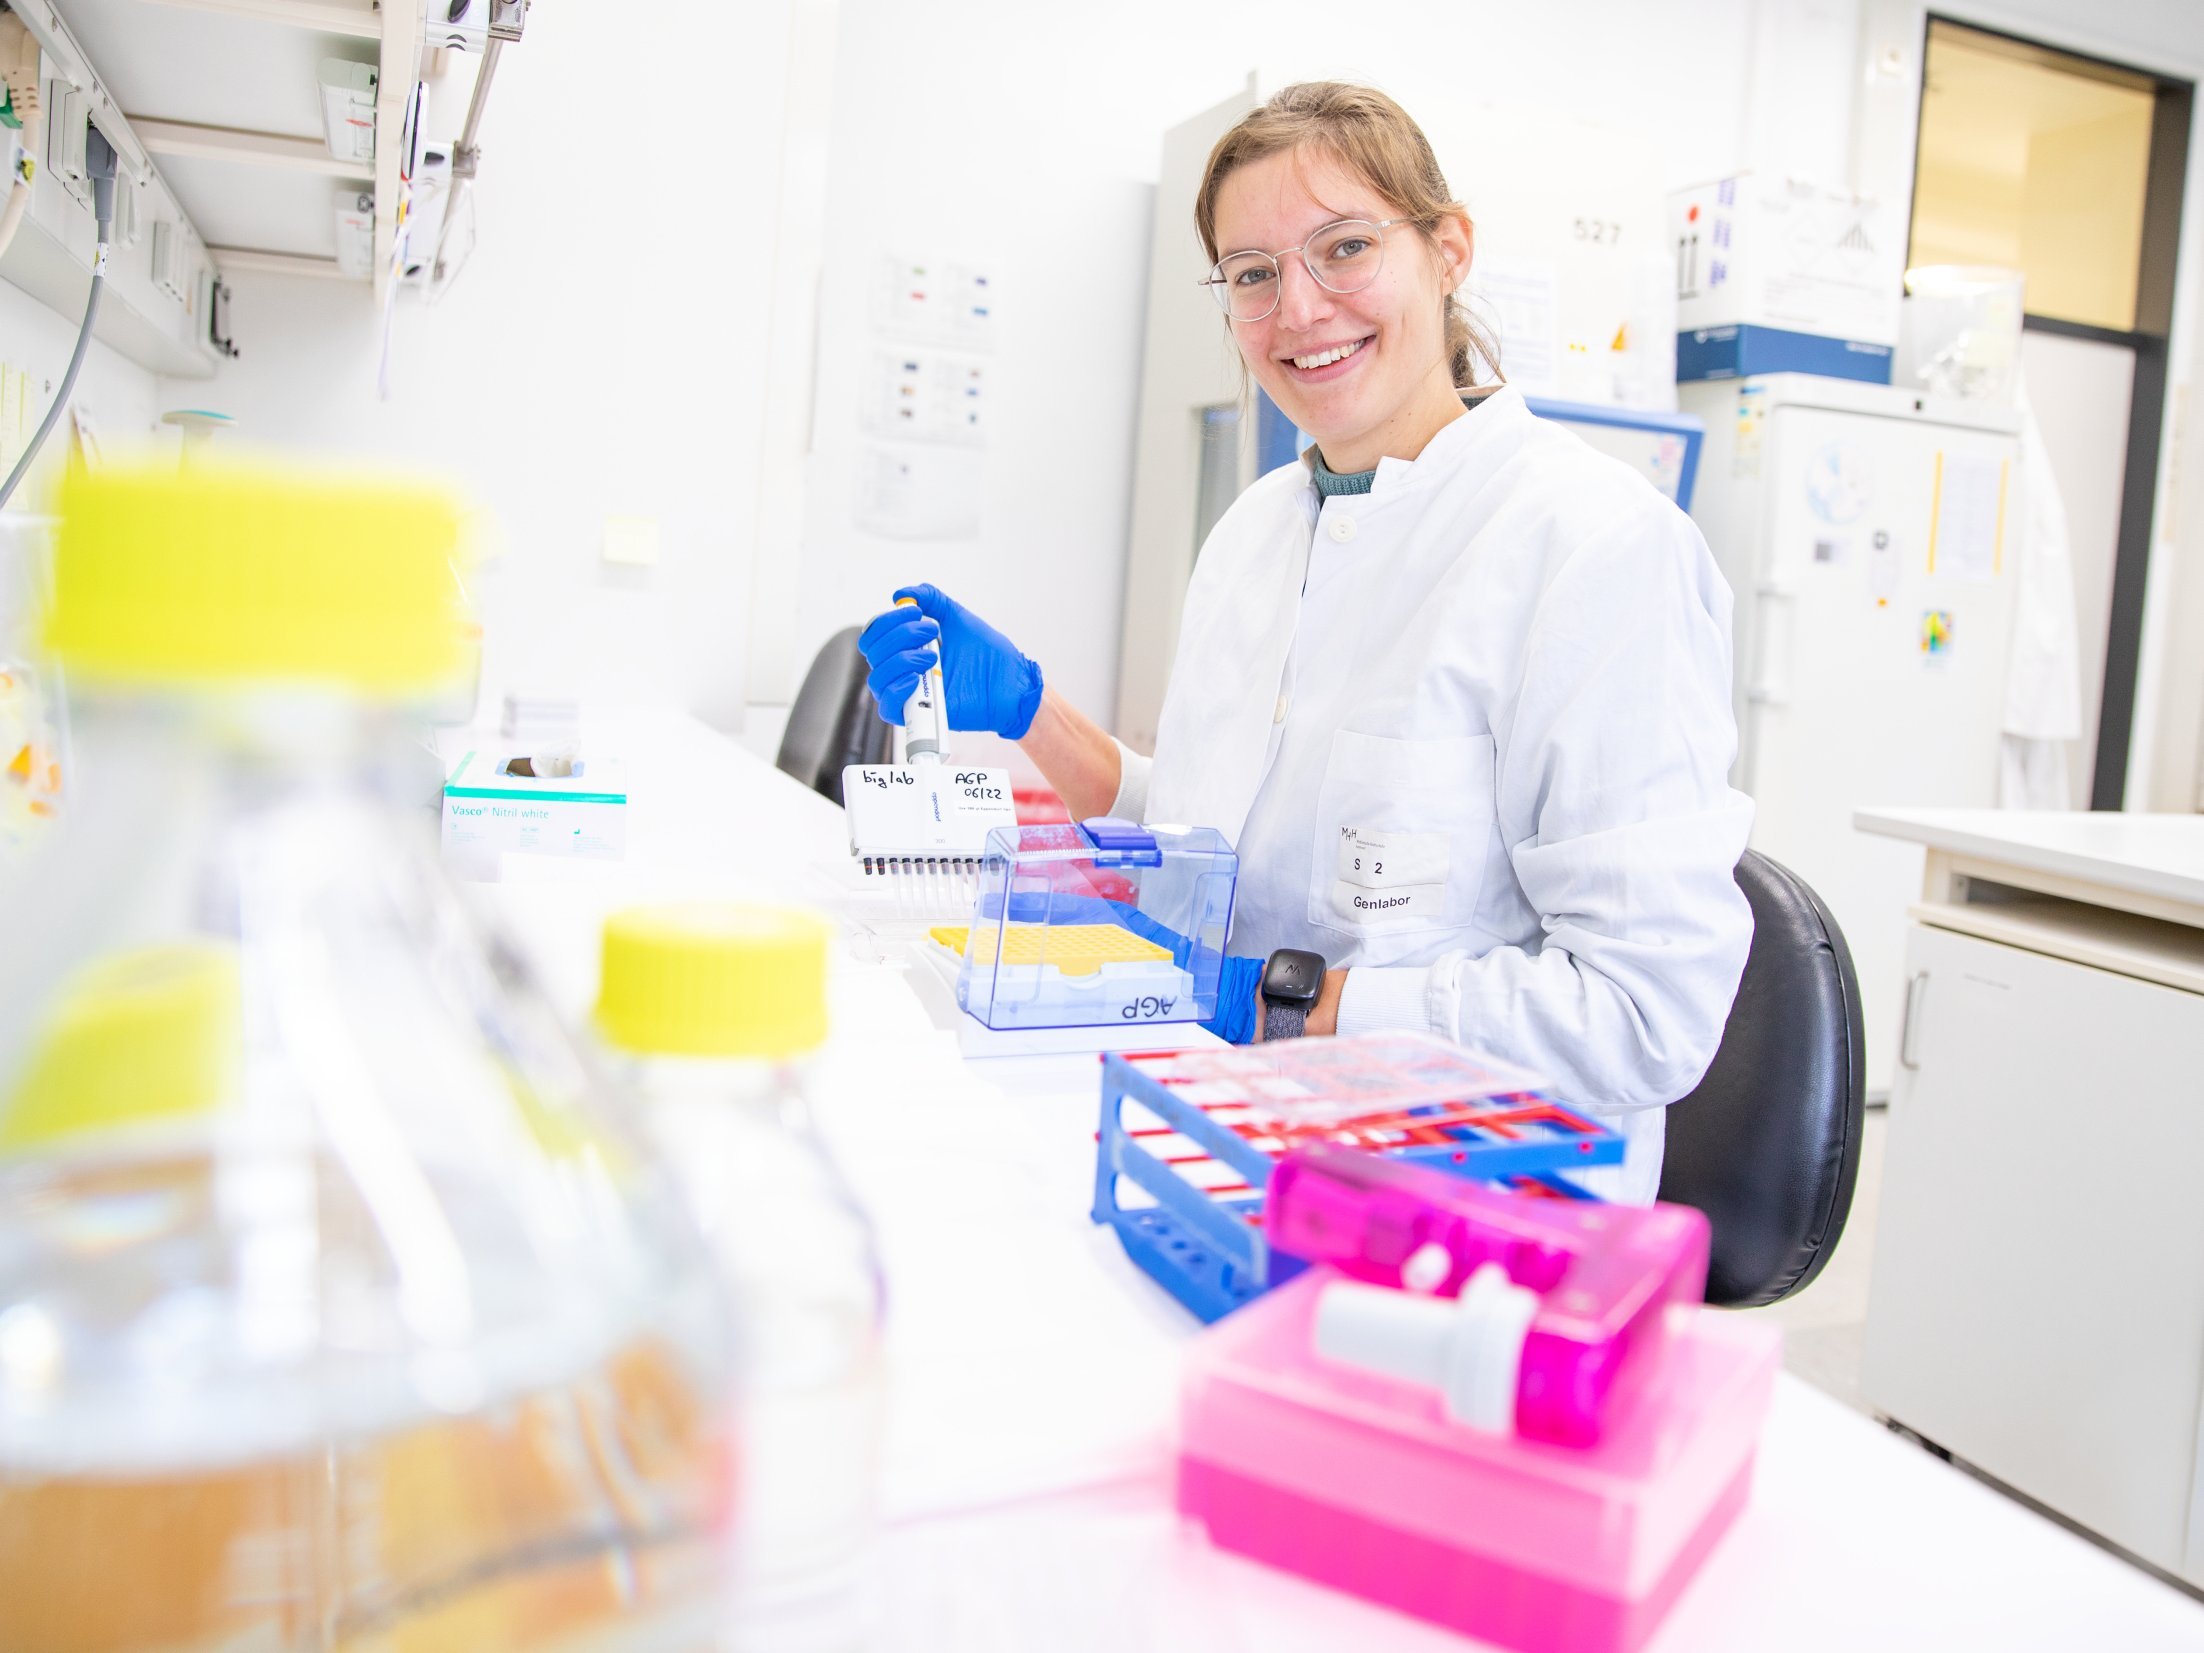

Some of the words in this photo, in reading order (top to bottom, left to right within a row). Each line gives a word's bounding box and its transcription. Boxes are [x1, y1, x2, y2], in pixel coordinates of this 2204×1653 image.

[1573, 217, 1621, 246] 527
[955, 773, 988, 784] AGP
[492, 807, 517, 817] Nitril
[521, 809, 549, 819] white
[1354, 858, 1361, 870] S
[1374, 862, 1383, 875] 2
[1353, 895, 1411, 910] Genlabor
[1121, 994, 1178, 1019] AGP
